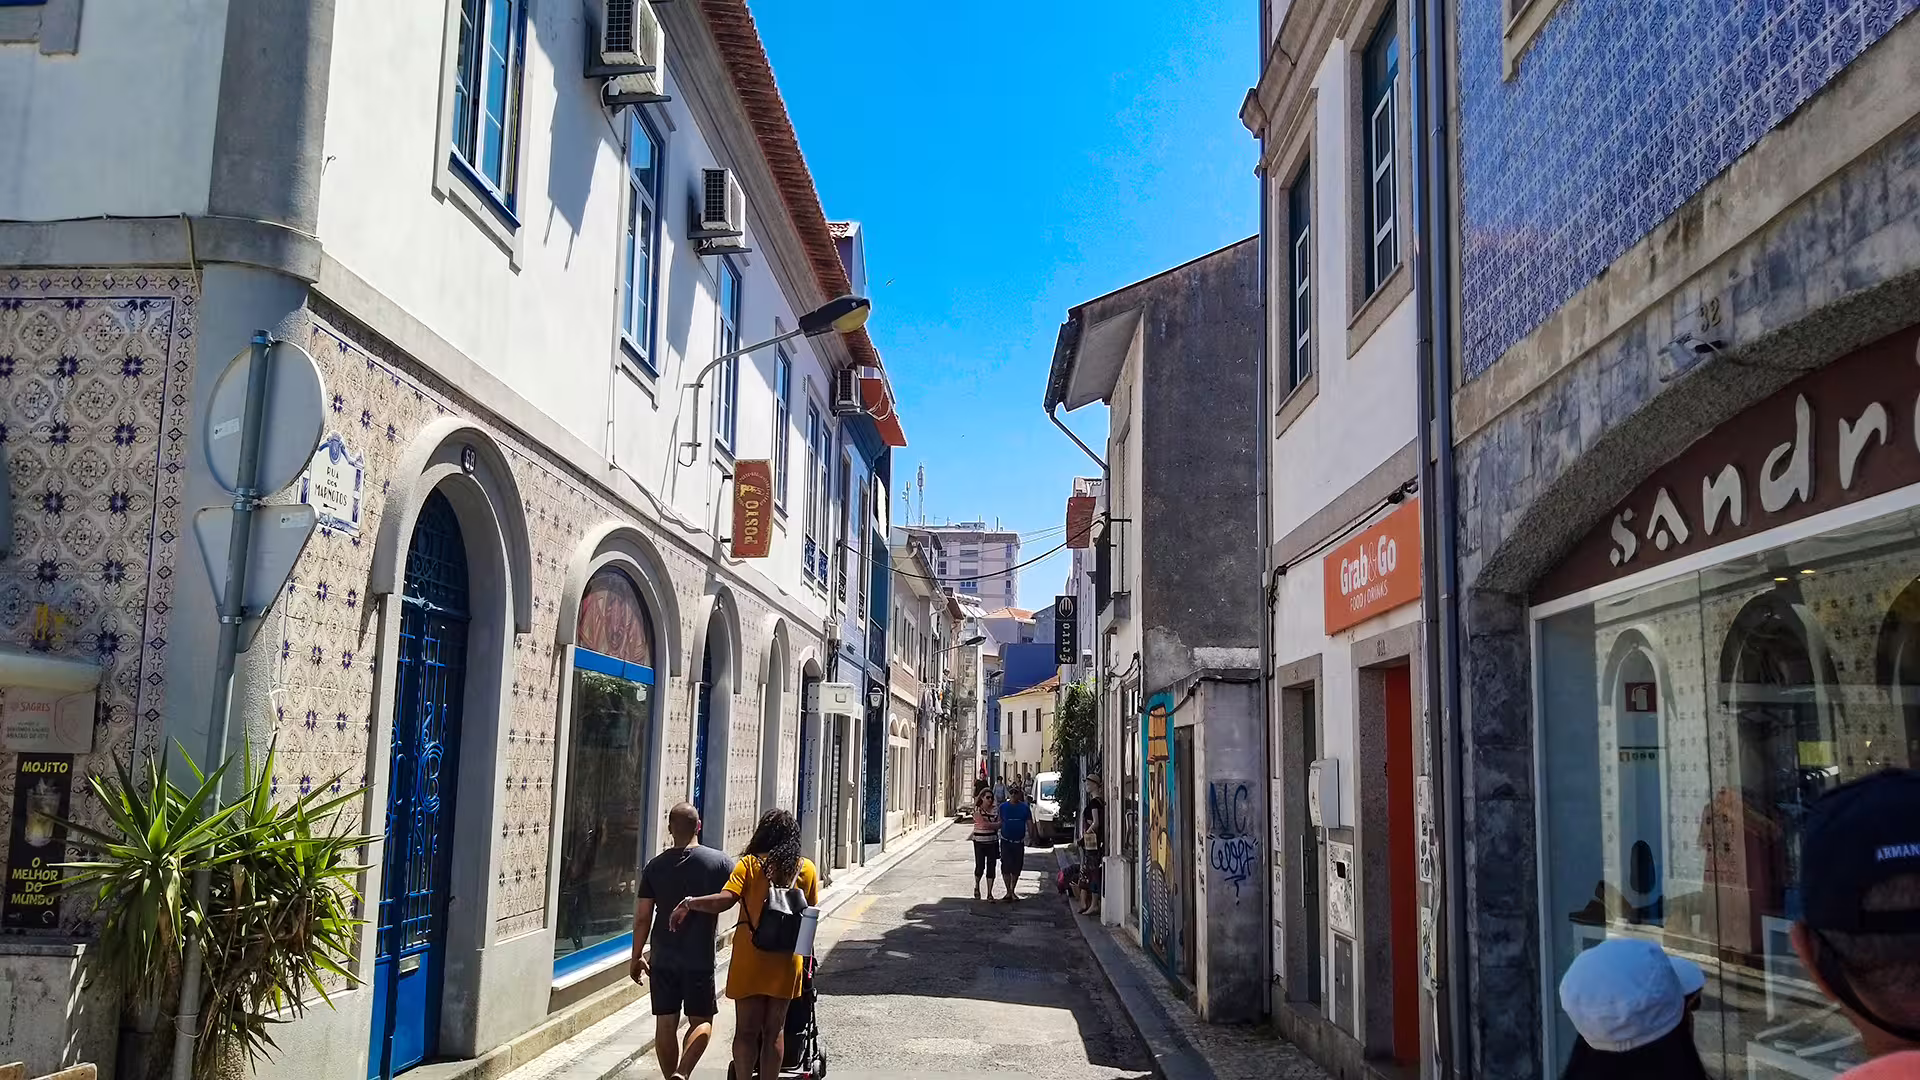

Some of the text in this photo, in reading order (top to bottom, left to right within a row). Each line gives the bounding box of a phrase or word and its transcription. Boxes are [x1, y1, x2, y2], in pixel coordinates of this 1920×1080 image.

[1701, 296, 1721, 332] 32
[326, 466, 339, 479] RUA
[1609, 392, 1920, 567] SAndr
[744, 500, 760, 545] POSTO
[20, 702, 51, 712] SAGRES
[31, 857, 41, 868] O
[12, 868, 59, 881] MELHOR
[25, 881, 43, 893] DO
